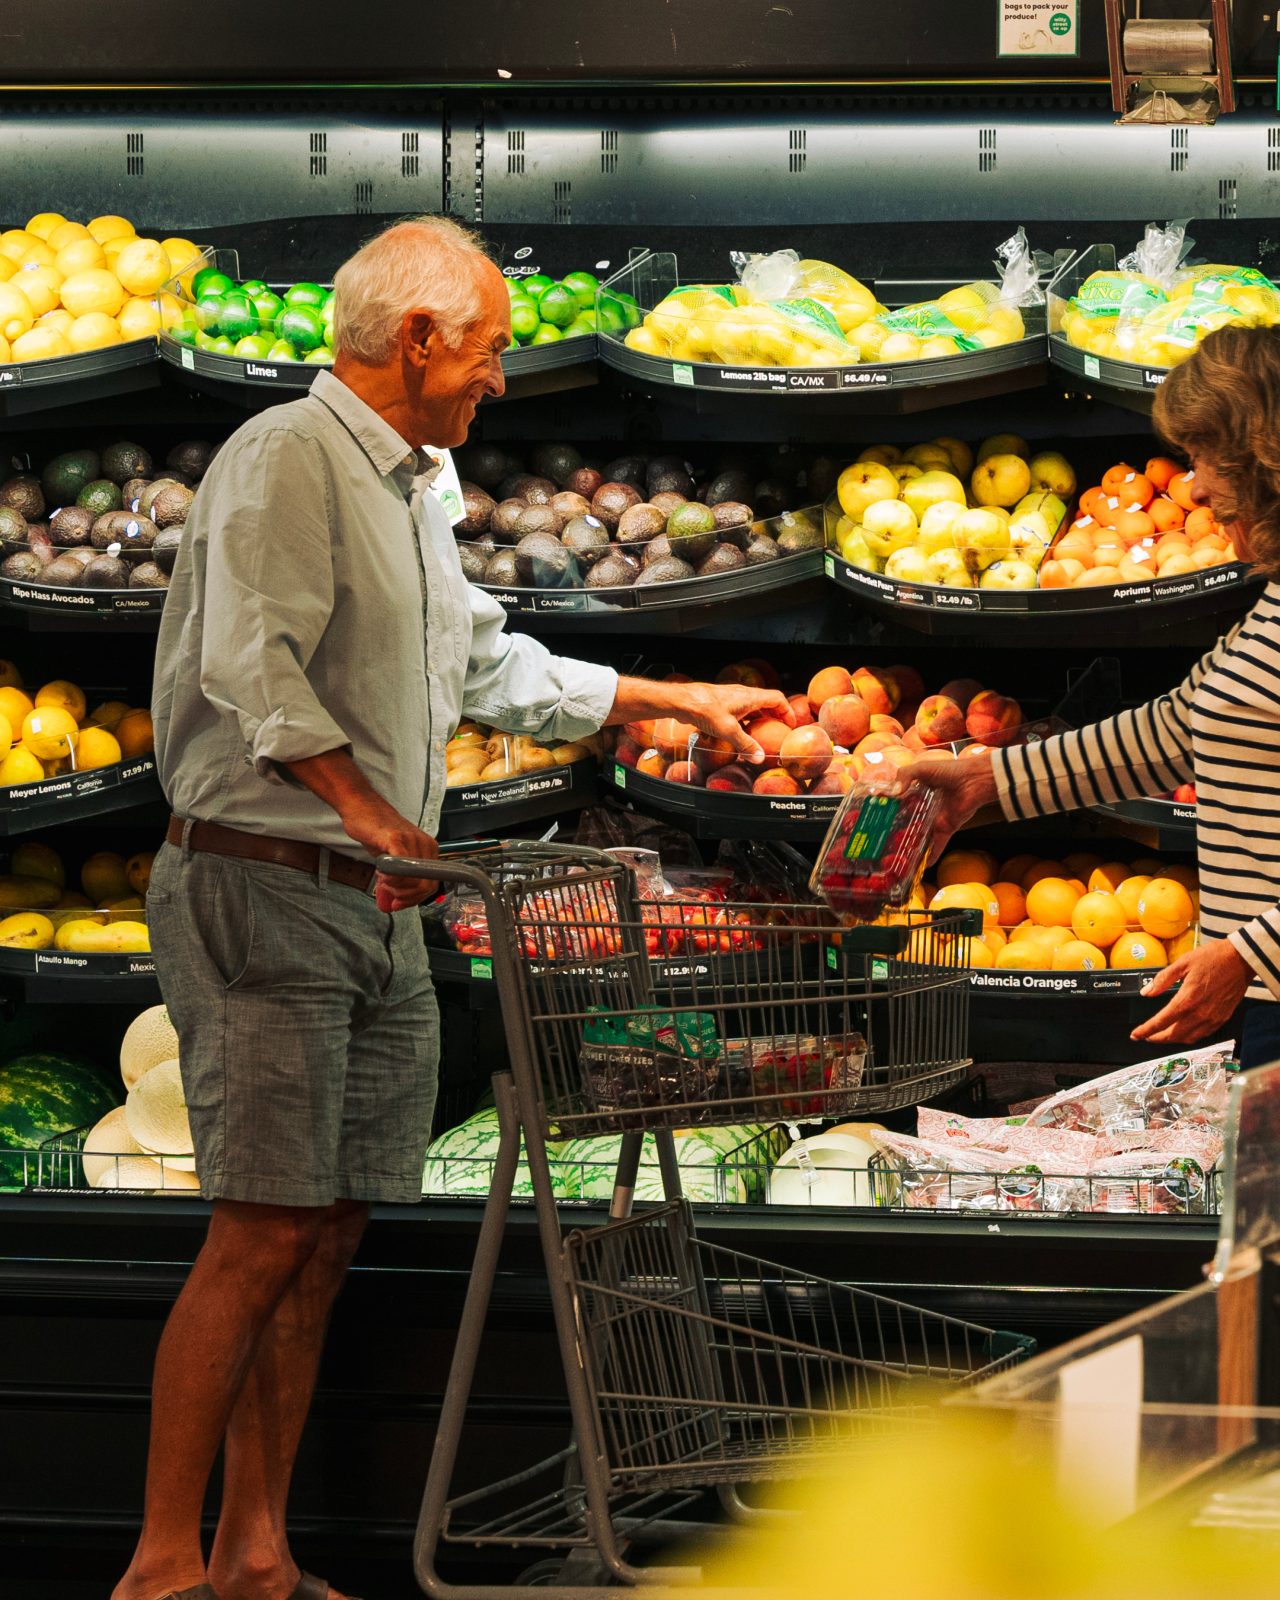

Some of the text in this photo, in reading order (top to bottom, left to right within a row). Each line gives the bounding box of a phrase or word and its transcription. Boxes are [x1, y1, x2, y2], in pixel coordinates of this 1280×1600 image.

[1004, 3, 1022, 11] bags
[1032, 3, 1050, 11] pack
[1004, 13, 1037, 21] produce!
[247, 364, 278, 378] Limes
[720, 370, 786, 383] Lemons 2lb bag
[790, 376, 825, 386] CA/MX
[844, 374, 871, 383] $6.49
[1204, 574, 1226, 587] $6.49
[12, 586, 95, 605] Ripe Hass Avocados
[896, 590, 924, 600] Argentina
[1113, 586, 1151, 598] Apriums
[1155, 583, 1195, 596] Washington
[115, 599, 149, 607] CA/Mexico
[937, 595, 959, 604] $2.49
[122, 764, 142, 779] $7.99
[9, 781, 72, 799] Meyer Lemons
[76, 778, 103, 791] California
[528, 780, 551, 791] $6.99
[462, 791, 479, 801] Kiwi
[481, 786, 525, 800] New Zealand
[770, 801, 806, 810] Peaches
[38, 955, 88, 967] Ataulfo Mango
[130, 962, 156, 973] Mexic
[969, 974, 1078, 990] Valencia Oranges
